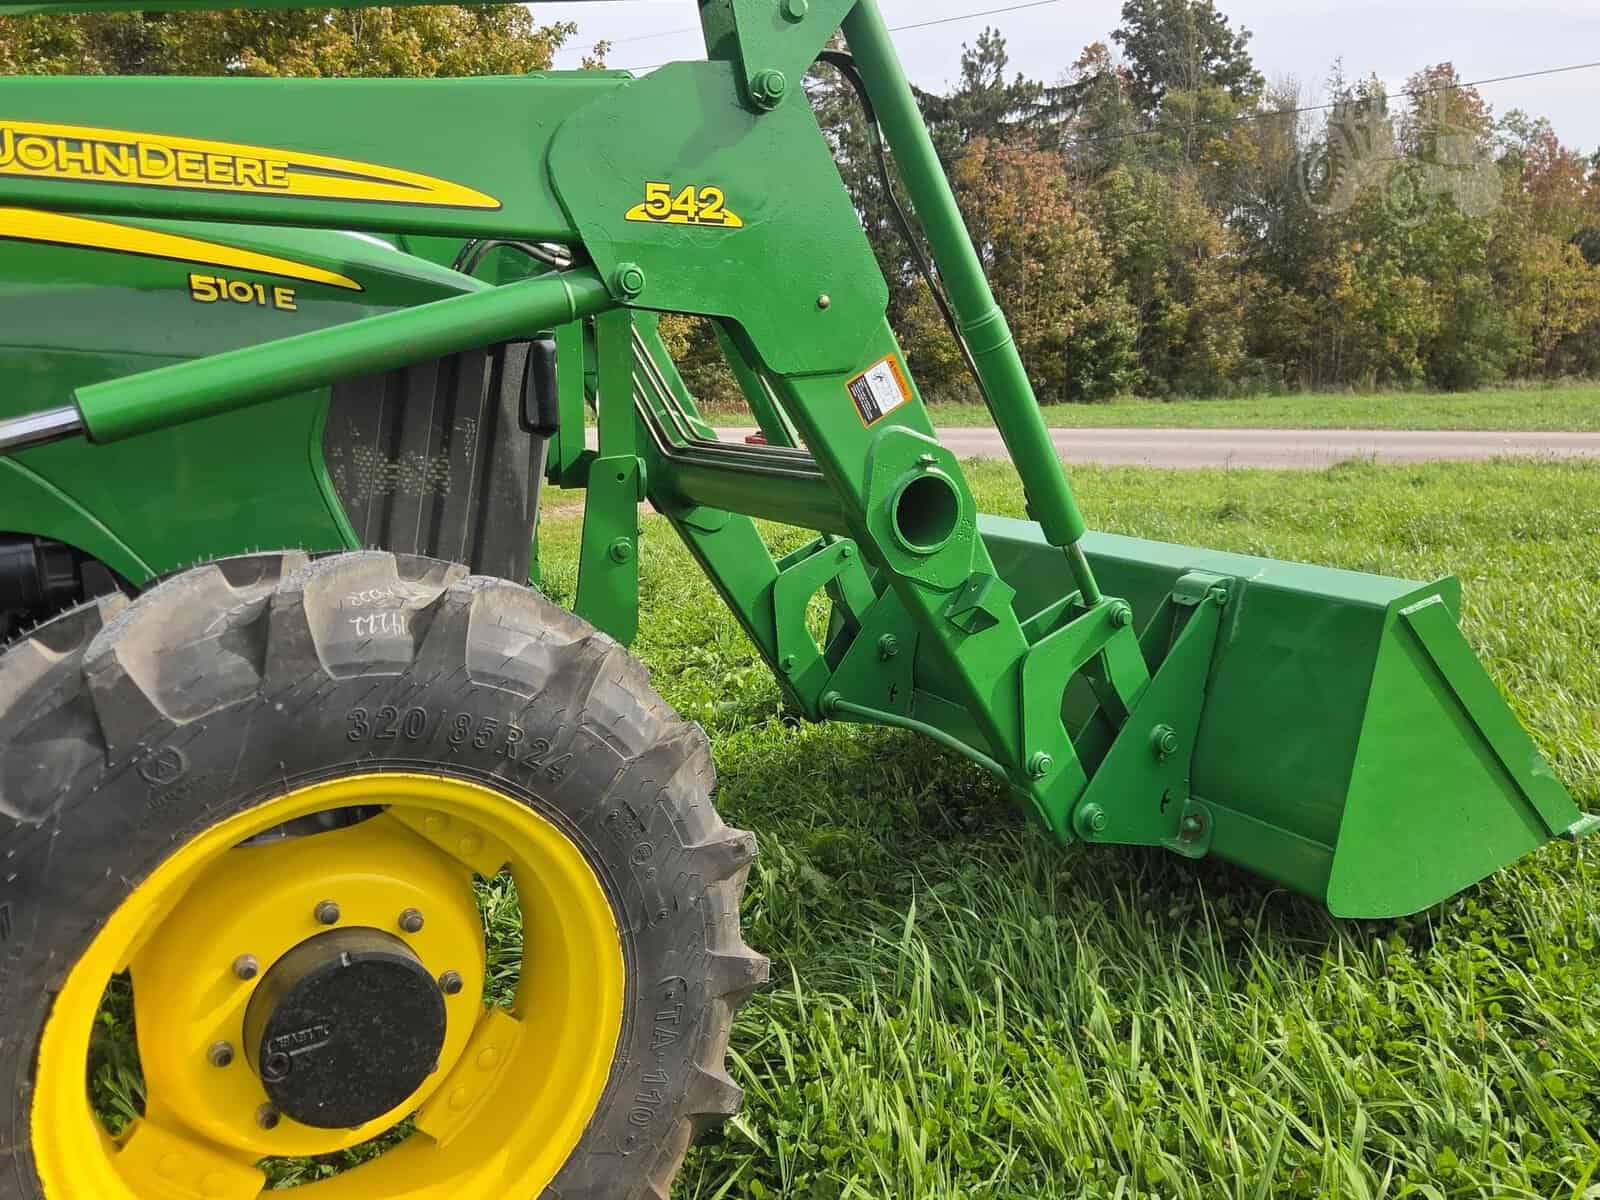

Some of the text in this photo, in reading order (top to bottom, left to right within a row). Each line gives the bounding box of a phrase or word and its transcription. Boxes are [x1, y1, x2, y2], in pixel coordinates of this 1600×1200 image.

[0, 128, 290, 189] JOHN DEERE
[645, 181, 725, 224] 542
